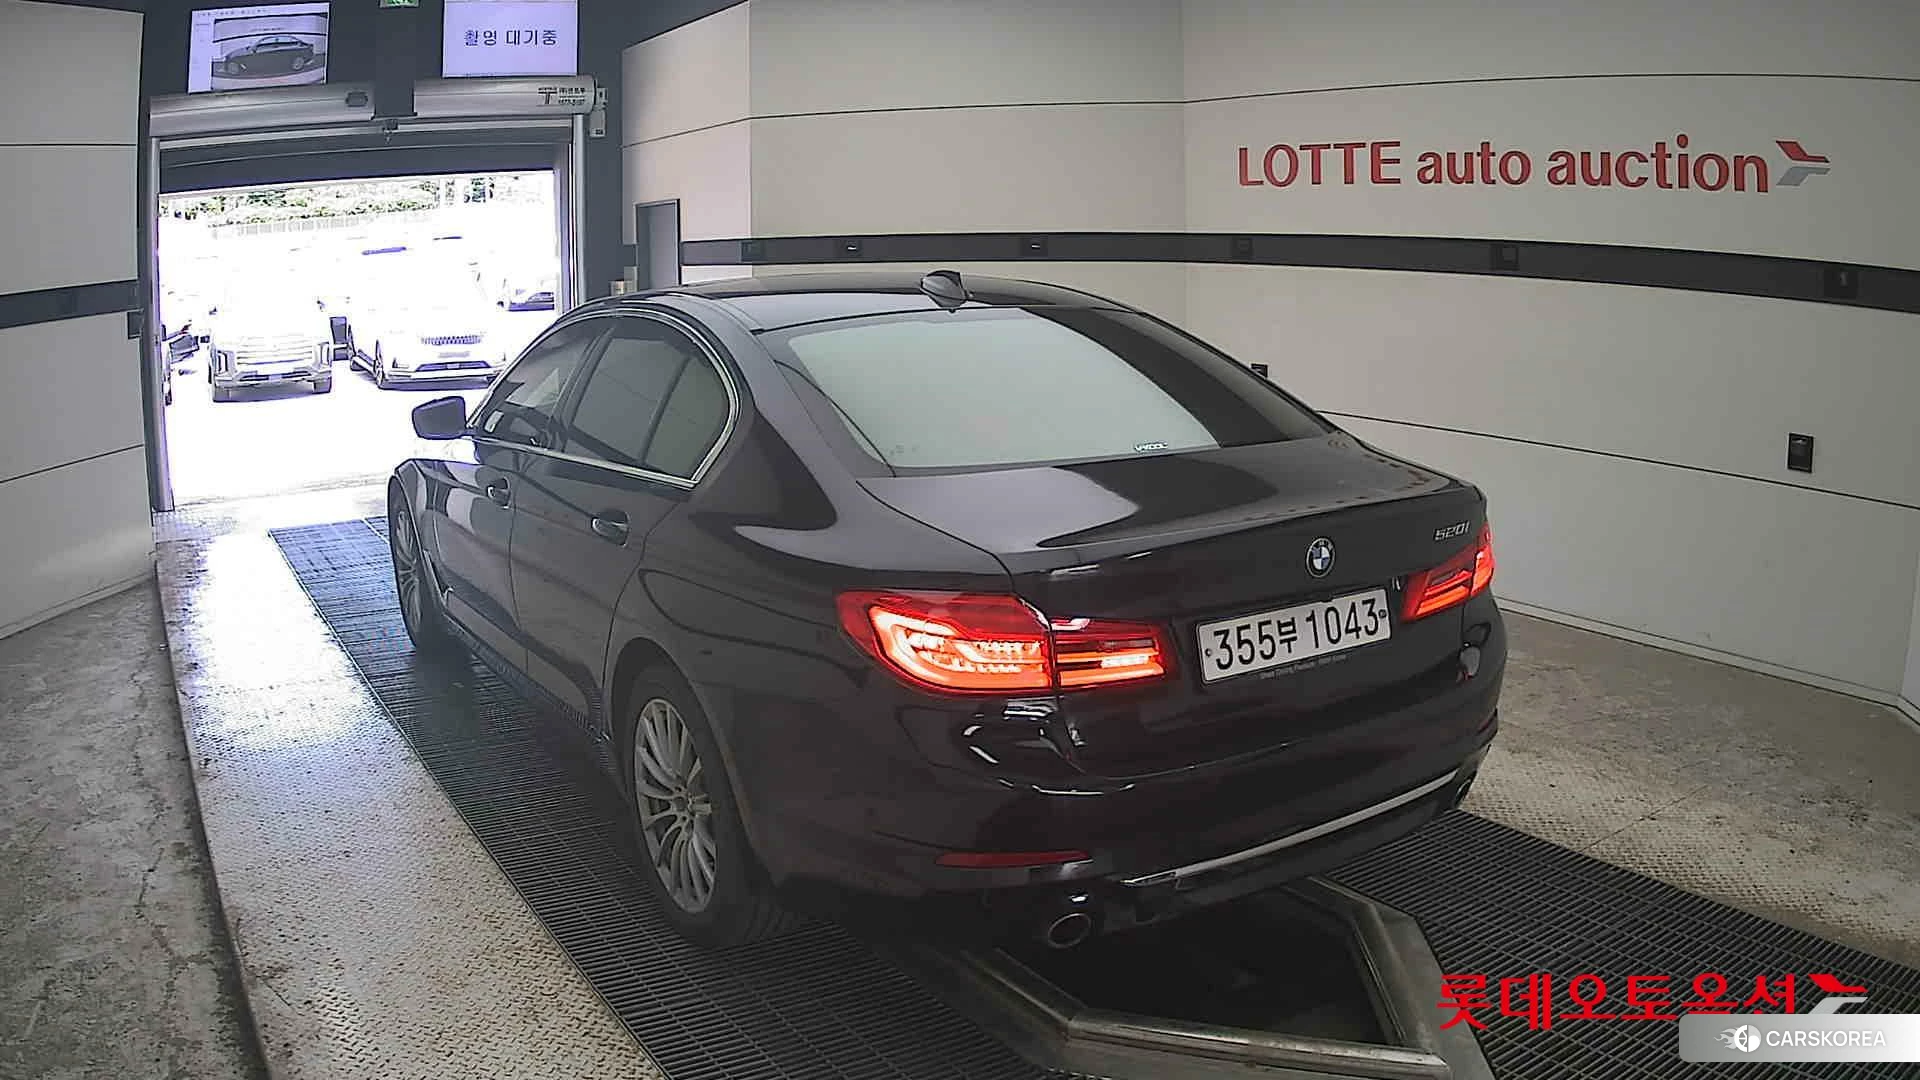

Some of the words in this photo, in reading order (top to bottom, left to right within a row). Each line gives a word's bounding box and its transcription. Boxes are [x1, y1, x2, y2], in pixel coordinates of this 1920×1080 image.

[506, 29, 557, 46] 대기중
[1238, 141, 1401, 187] LOTTE
[1417, 141, 1531, 186] auto
[1547, 134, 1769, 193] auction
[1434, 521, 1470, 541] 520i
[1305, 597, 1380, 649] 1043
